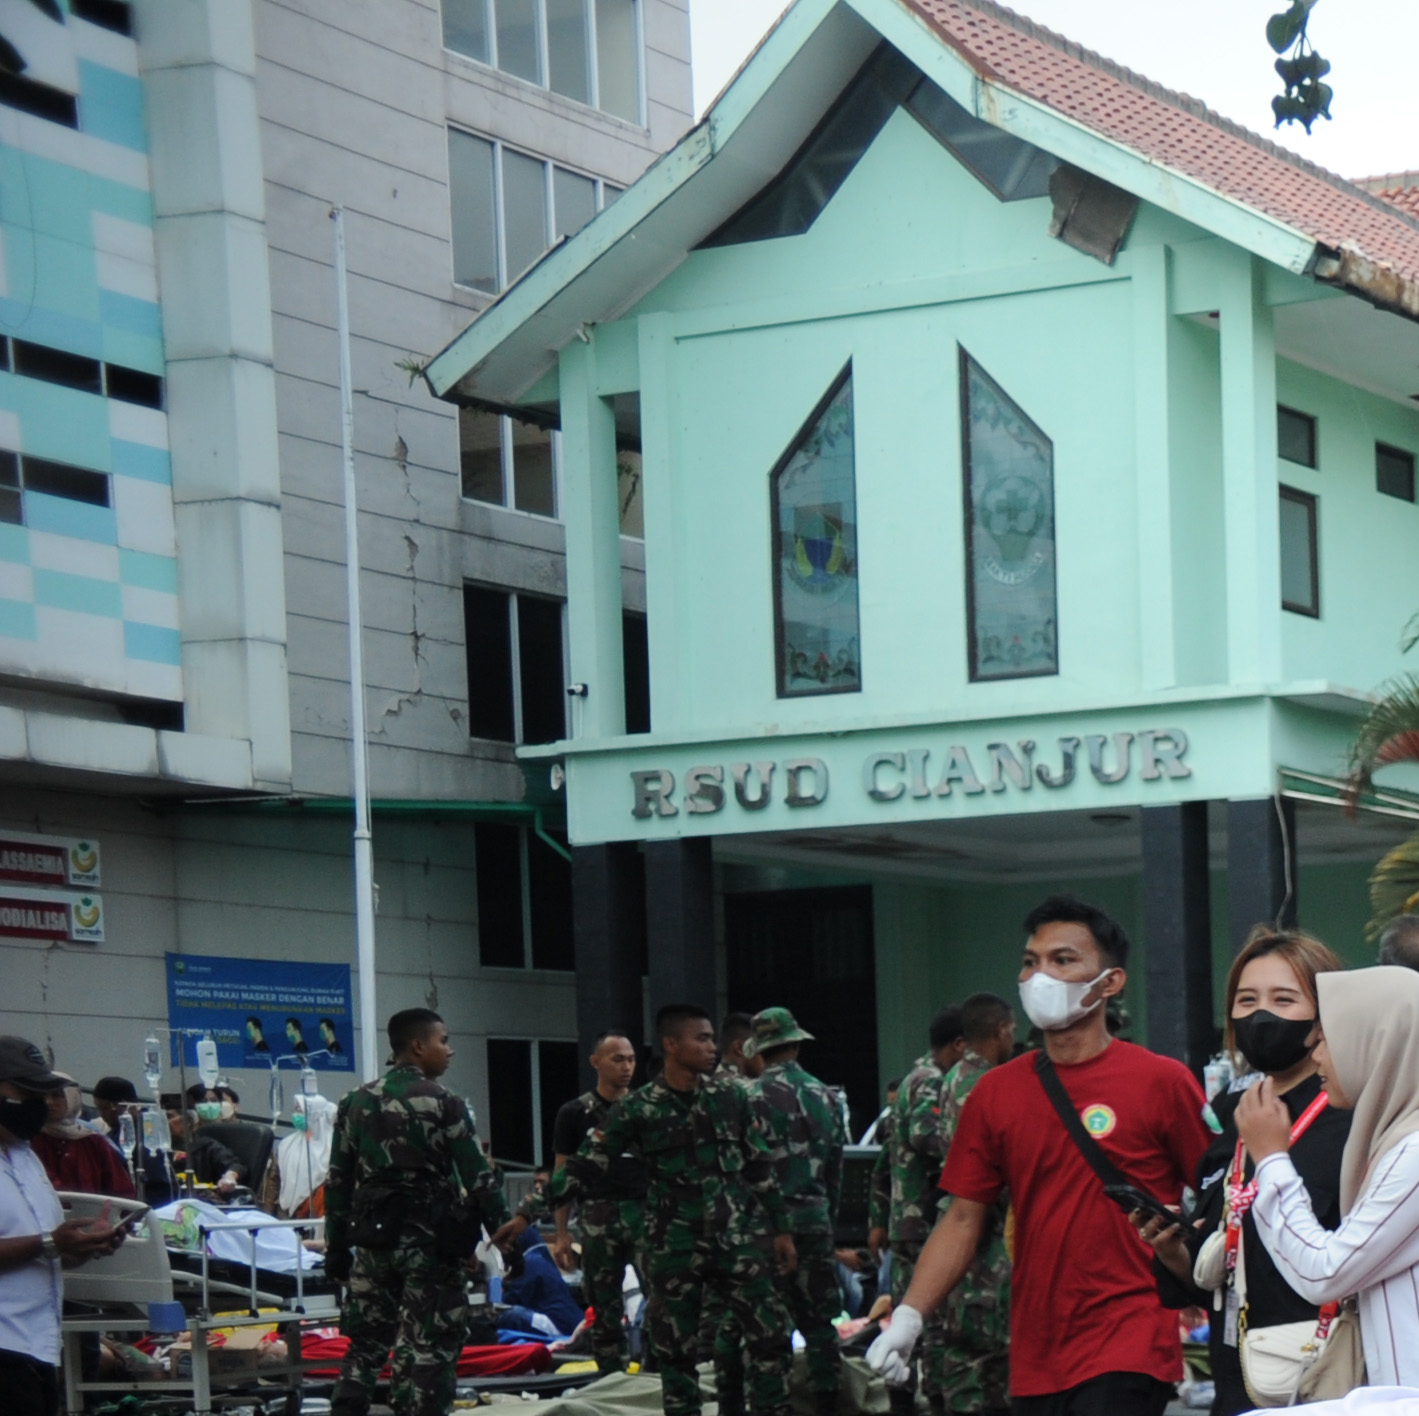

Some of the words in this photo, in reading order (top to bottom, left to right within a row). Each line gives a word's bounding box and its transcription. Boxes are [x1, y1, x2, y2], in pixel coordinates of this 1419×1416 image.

[630, 757, 830, 820] RSUD
[863, 727, 1192, 801] CIANJUR
[176, 989, 211, 998] MOHON
[213, 991, 239, 999] PAKAI
[241, 992, 277, 1002] MASKER
[278, 994, 314, 1003] DENGAN
